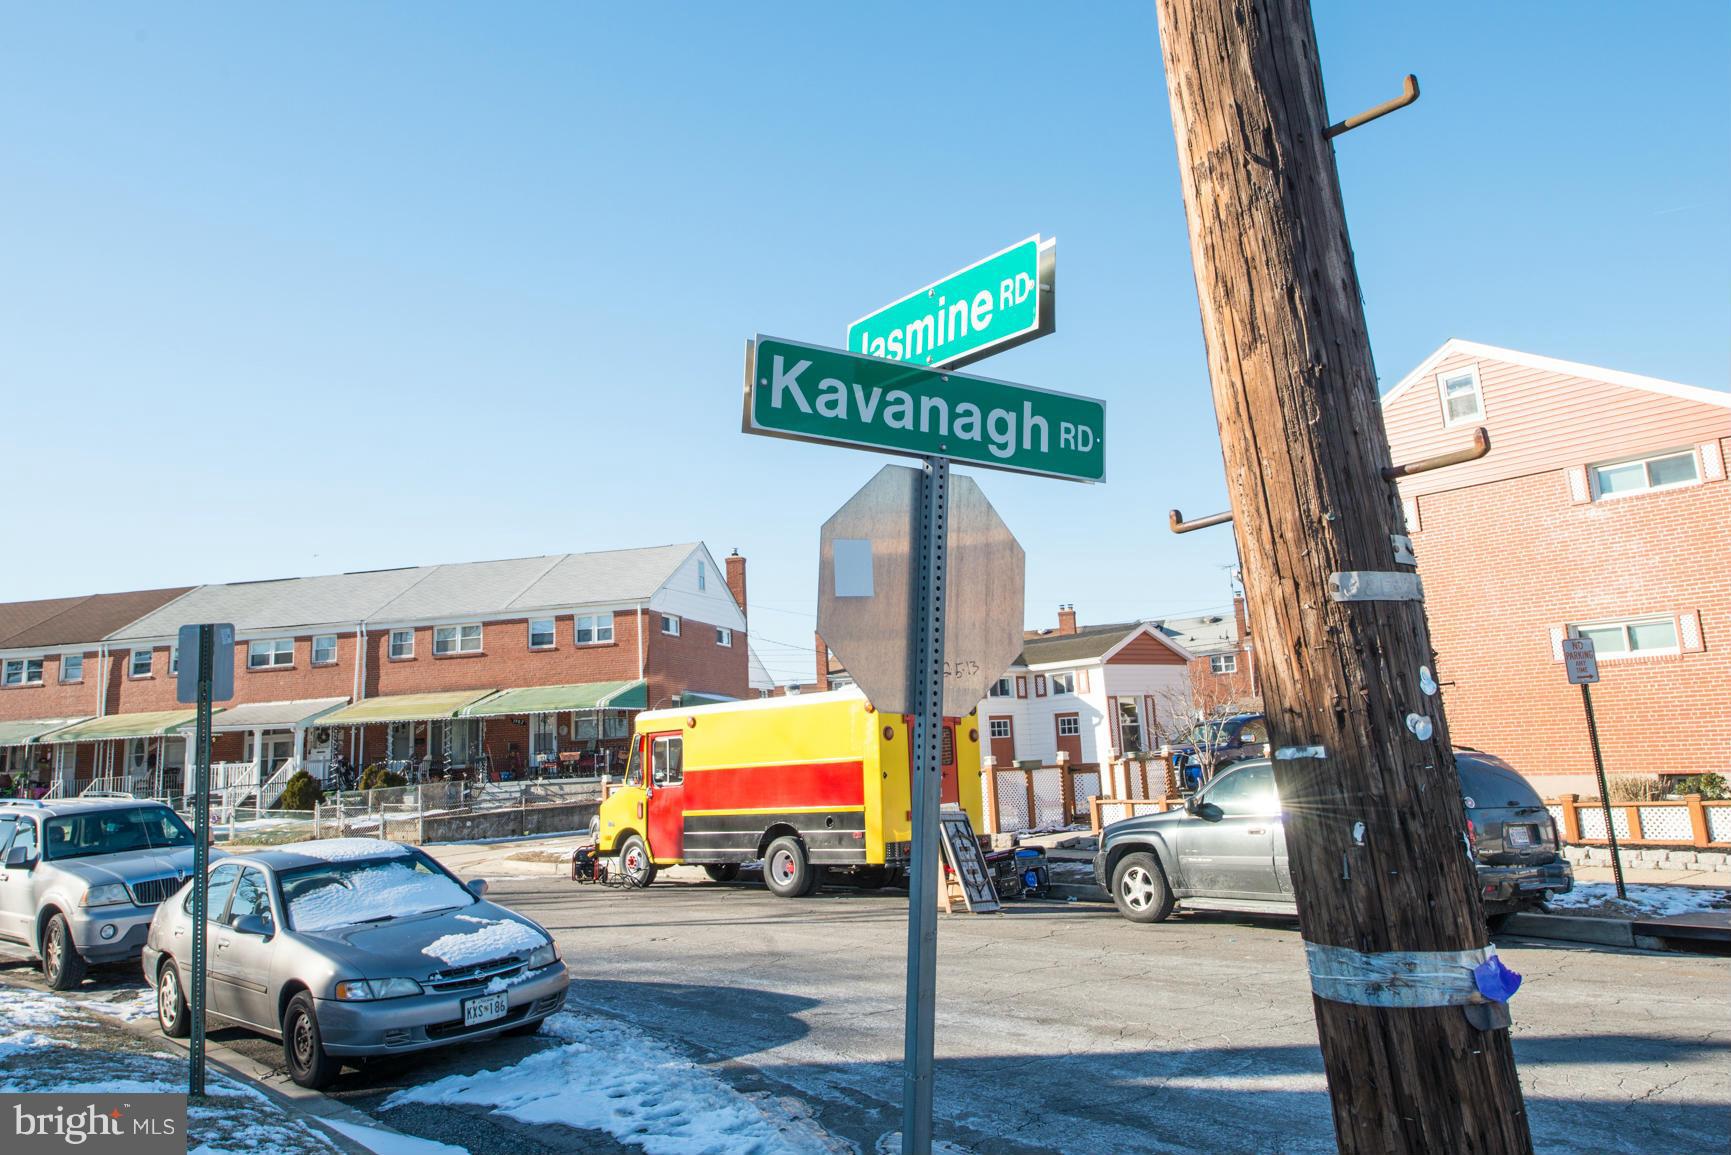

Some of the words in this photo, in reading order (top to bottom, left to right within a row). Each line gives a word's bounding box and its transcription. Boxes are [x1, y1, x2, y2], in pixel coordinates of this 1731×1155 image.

[999, 270, 1031, 312] RD
[771, 355, 1049, 459] Kavanagh
[1060, 421, 1093, 453] RD
[1565, 650, 1594, 661] PARKING
[1572, 641, 1584, 650] NO
[467, 1004, 484, 1020] KXS
[490, 1000, 506, 1015] 186
